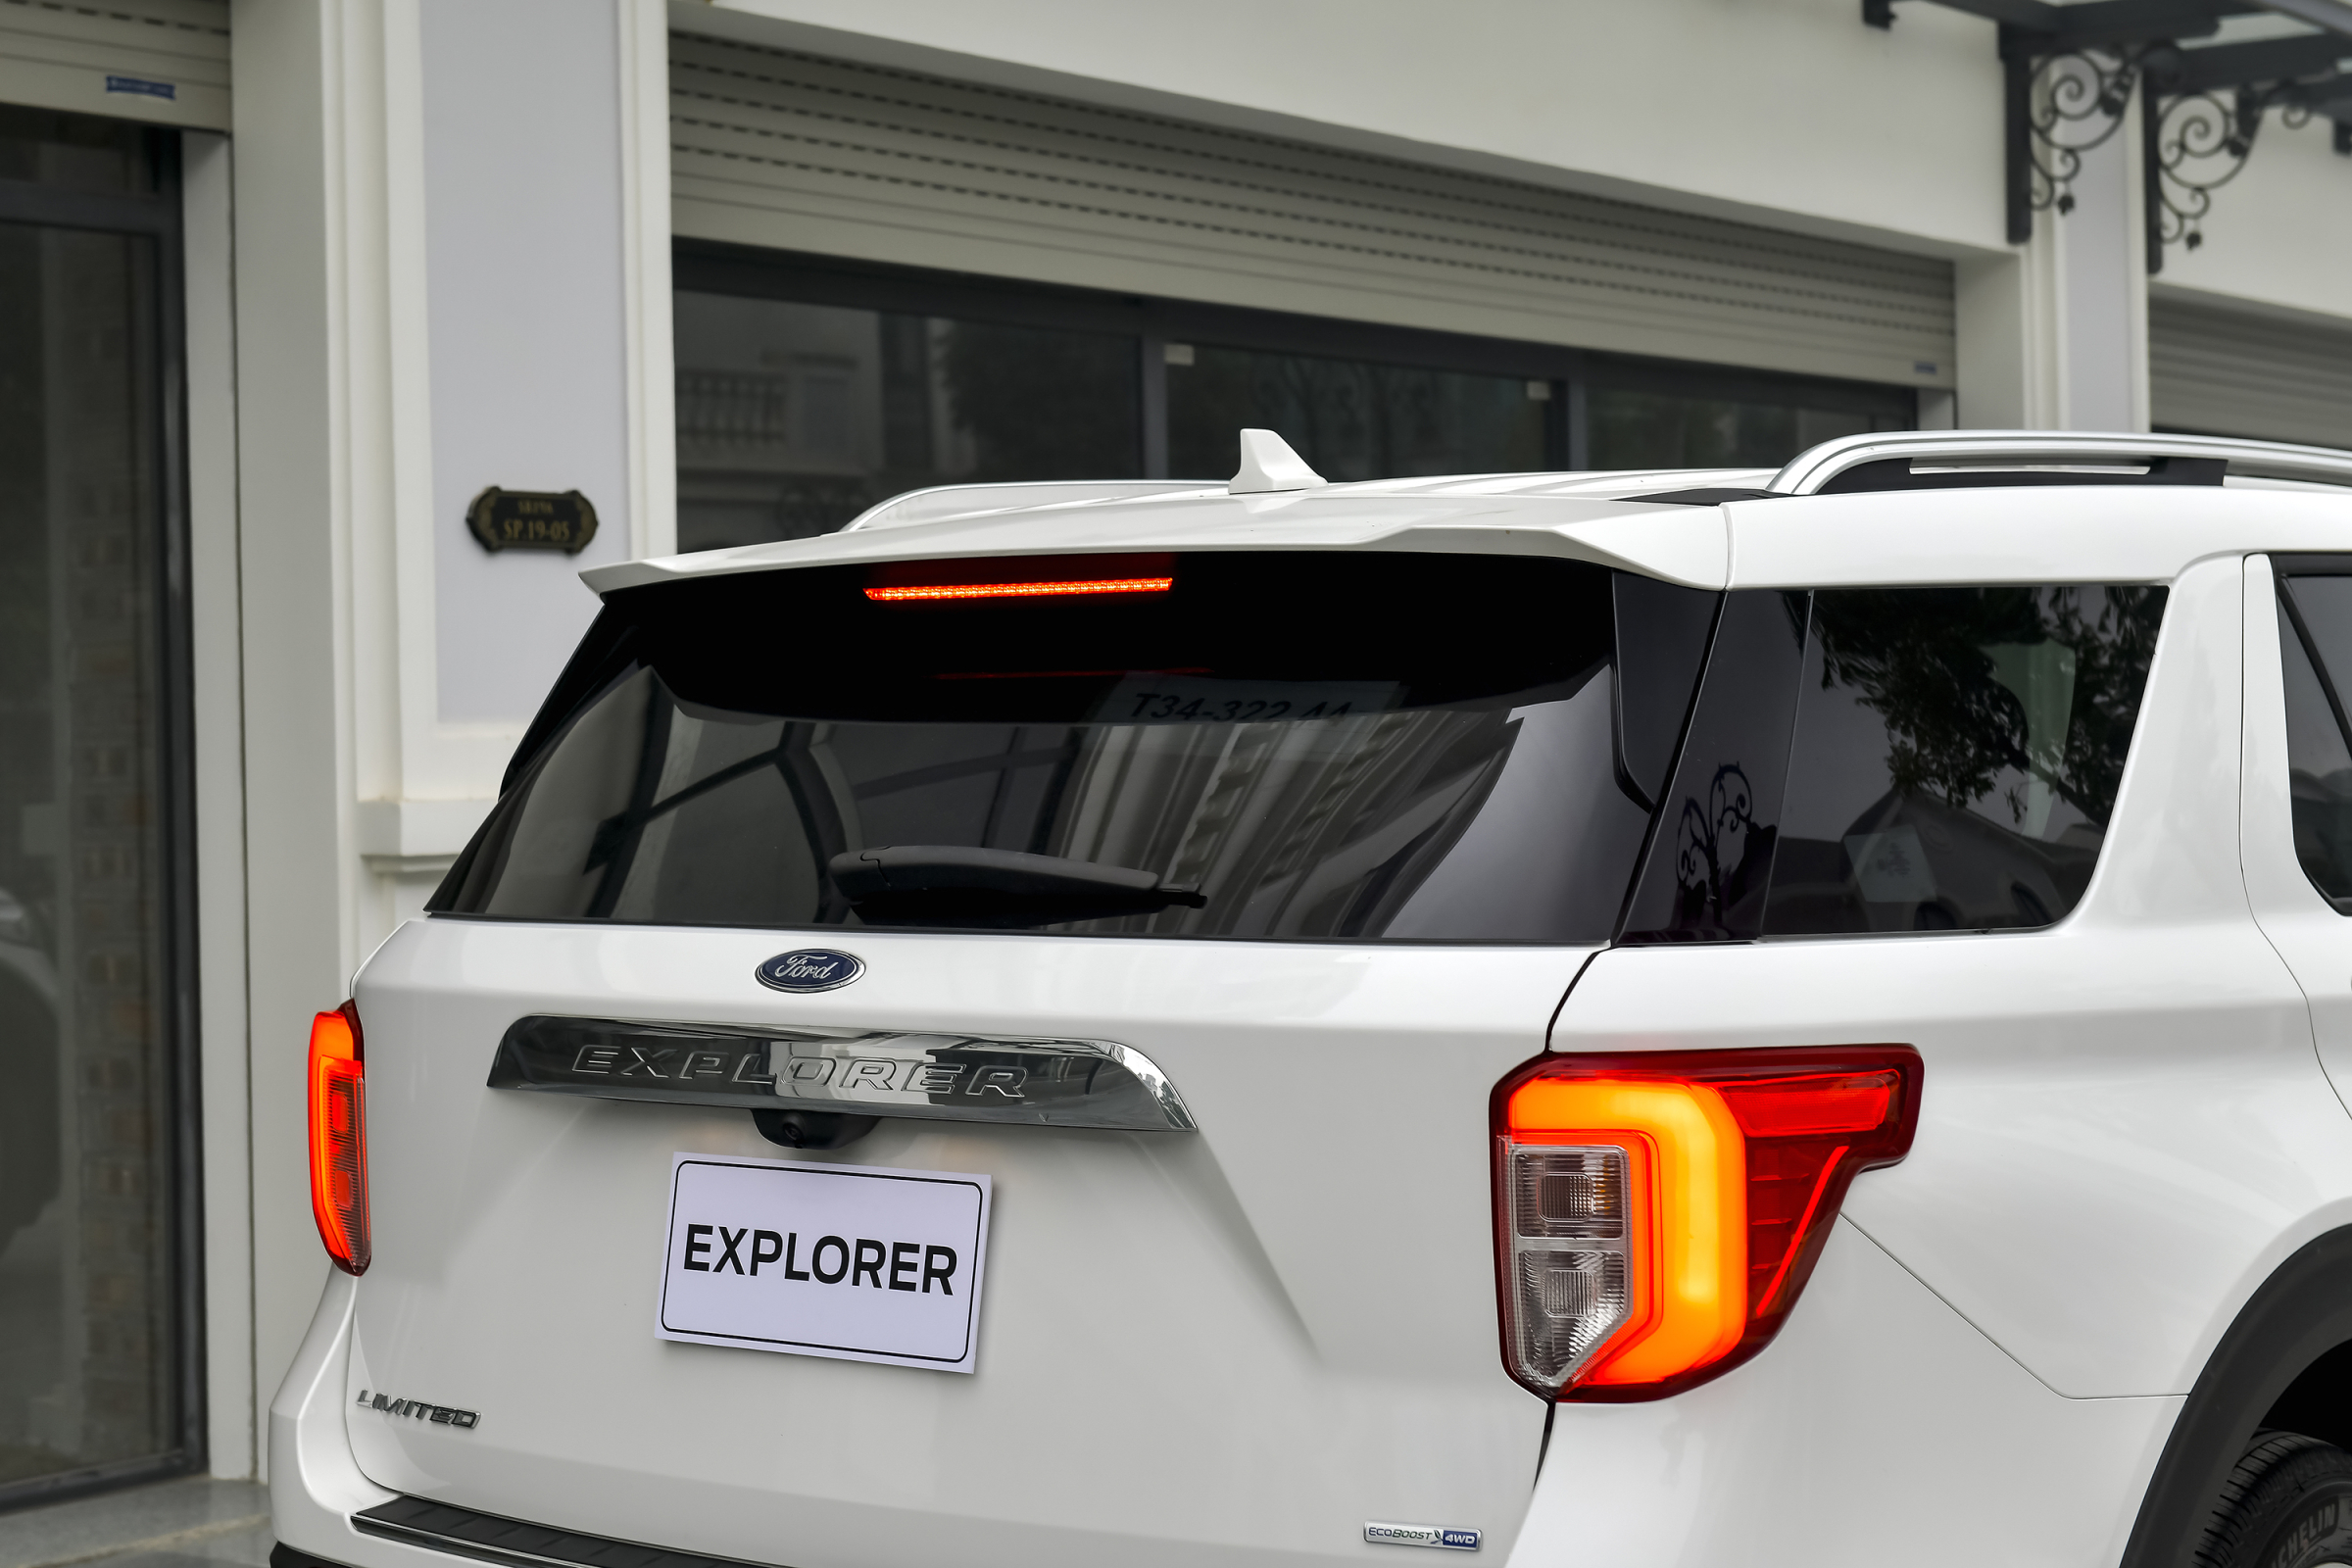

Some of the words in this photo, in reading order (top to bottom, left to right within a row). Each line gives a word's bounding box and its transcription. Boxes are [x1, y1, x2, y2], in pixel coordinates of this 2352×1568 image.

[774, 955, 839, 979] Ford
[571, 1044, 1028, 1098] EXPLORER
[683, 1223, 957, 1297] EXPLORER
[356, 1389, 482, 1430] LIMITED
[1445, 1534, 1476, 1545] 4WD
